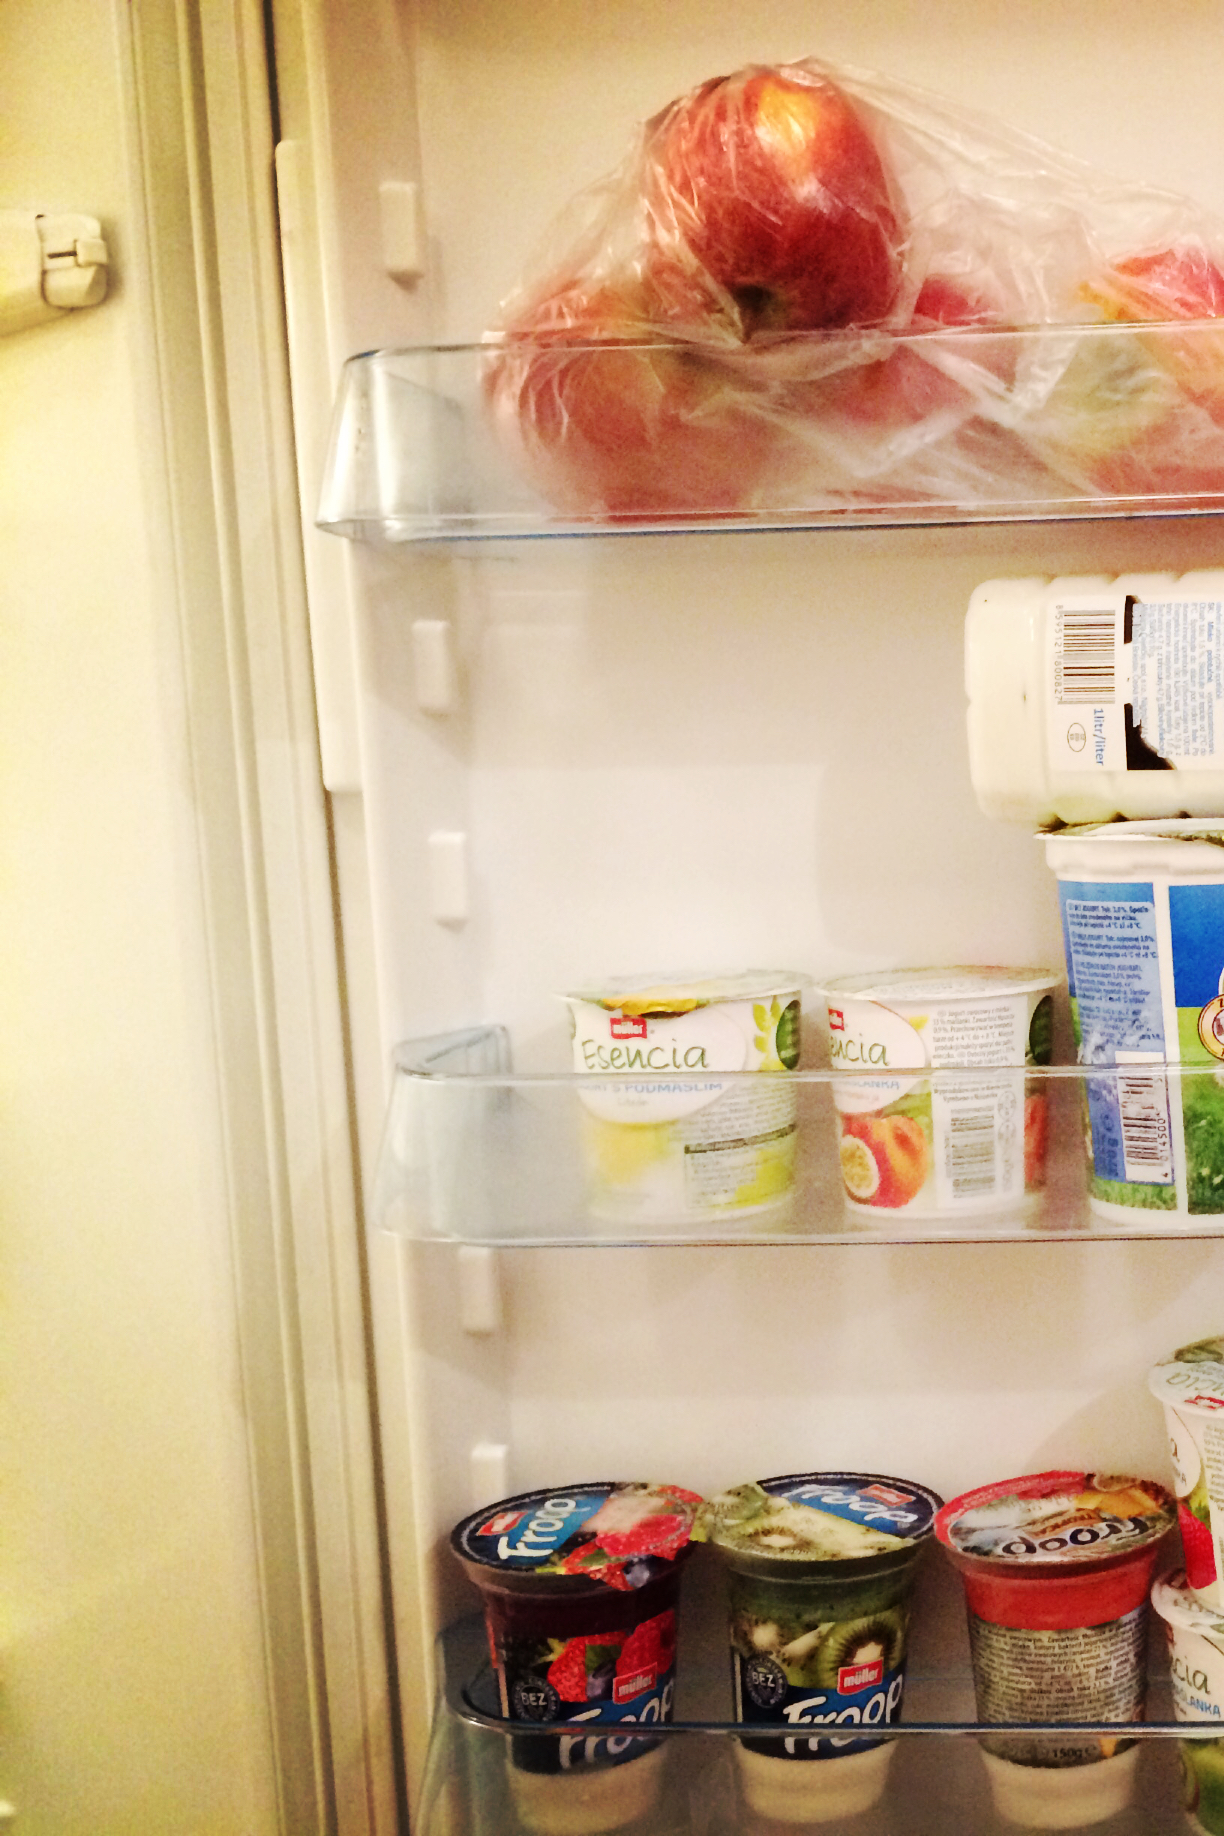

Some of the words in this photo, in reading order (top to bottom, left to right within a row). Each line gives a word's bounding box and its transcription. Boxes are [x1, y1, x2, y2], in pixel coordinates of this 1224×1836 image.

[581, 1038, 709, 1070] Esencia
[497, 1497, 593, 1561] Froop
[617, 1674, 653, 1697] müller
[751, 1671, 776, 1688] BEZ
[843, 1666, 880, 1688] müller
[520, 1691, 548, 1707] BEZ
[782, 1673, 904, 1754] Froop
